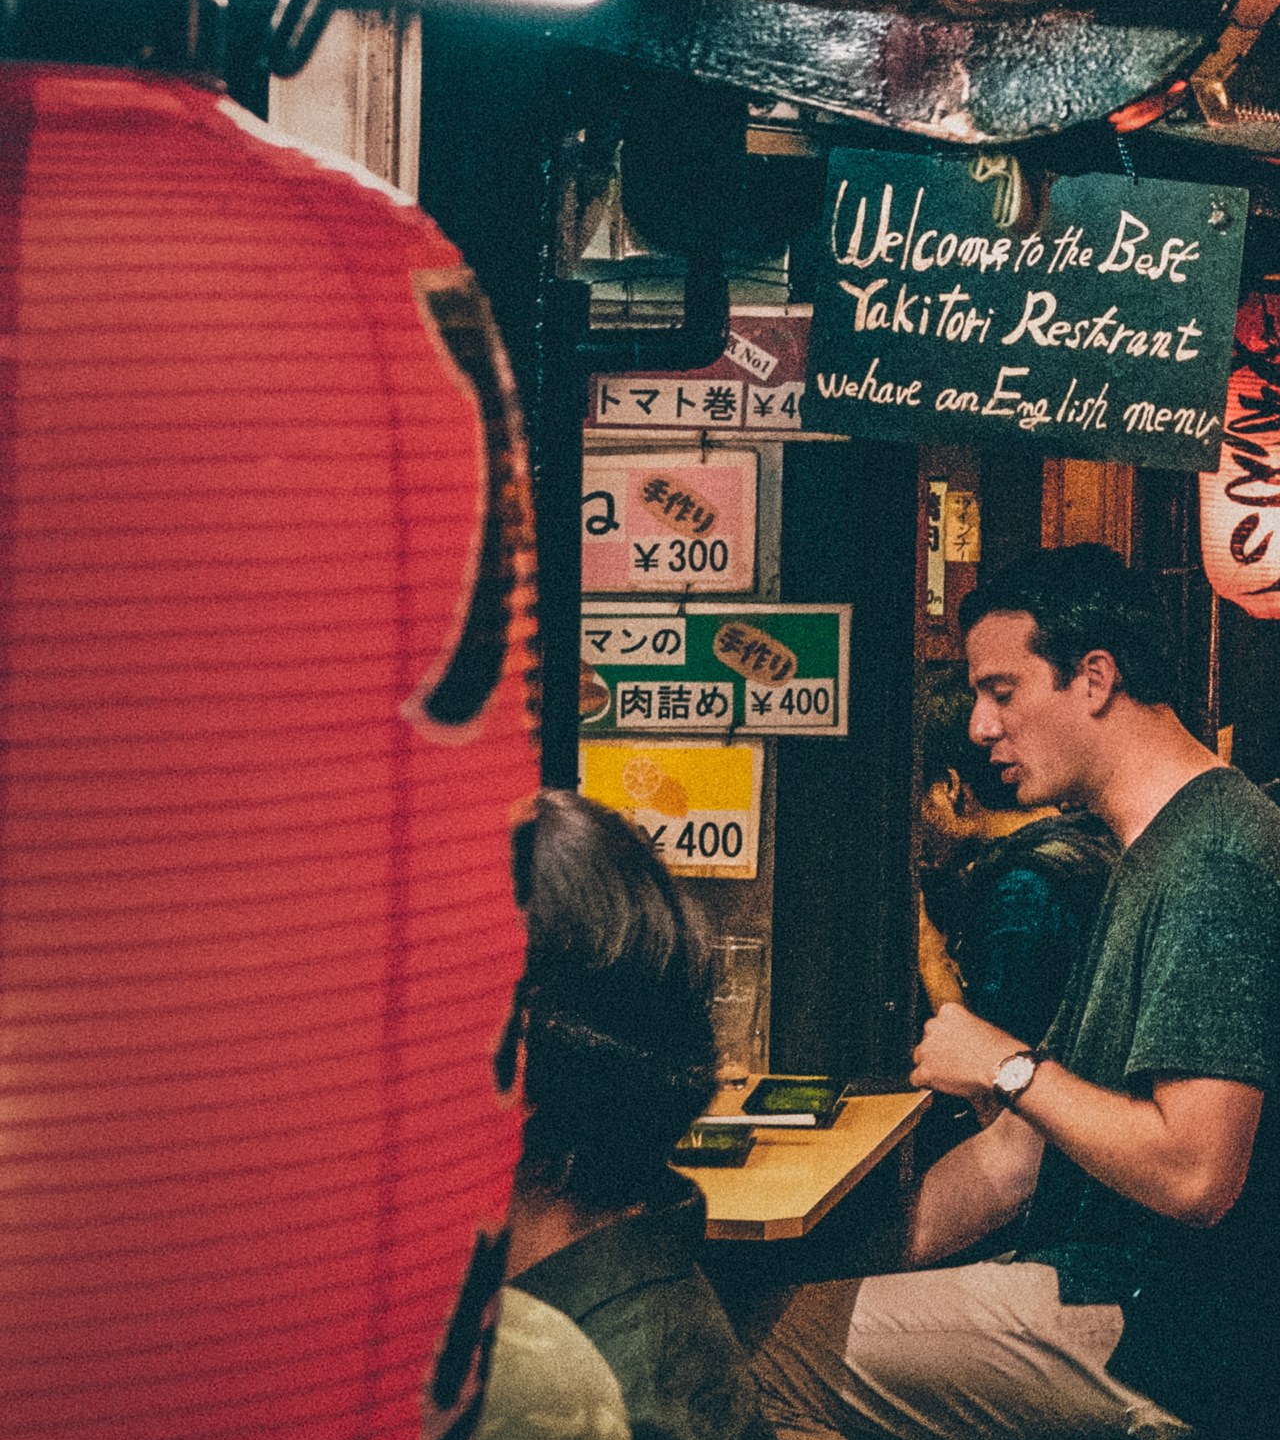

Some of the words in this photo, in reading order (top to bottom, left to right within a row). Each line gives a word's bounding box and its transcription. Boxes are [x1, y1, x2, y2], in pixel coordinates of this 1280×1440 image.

[831, 179, 1012, 274] Welcome
[1013, 232, 1041, 273] to
[1047, 225, 1093, 274] the
[1098, 209, 1200, 283] Best
[752, 391, 802, 419] ¥4
[632, 538, 729, 573] ¥300
[620, 684, 729, 720] 肉詰め
[750, 687, 830, 716] ¥400
